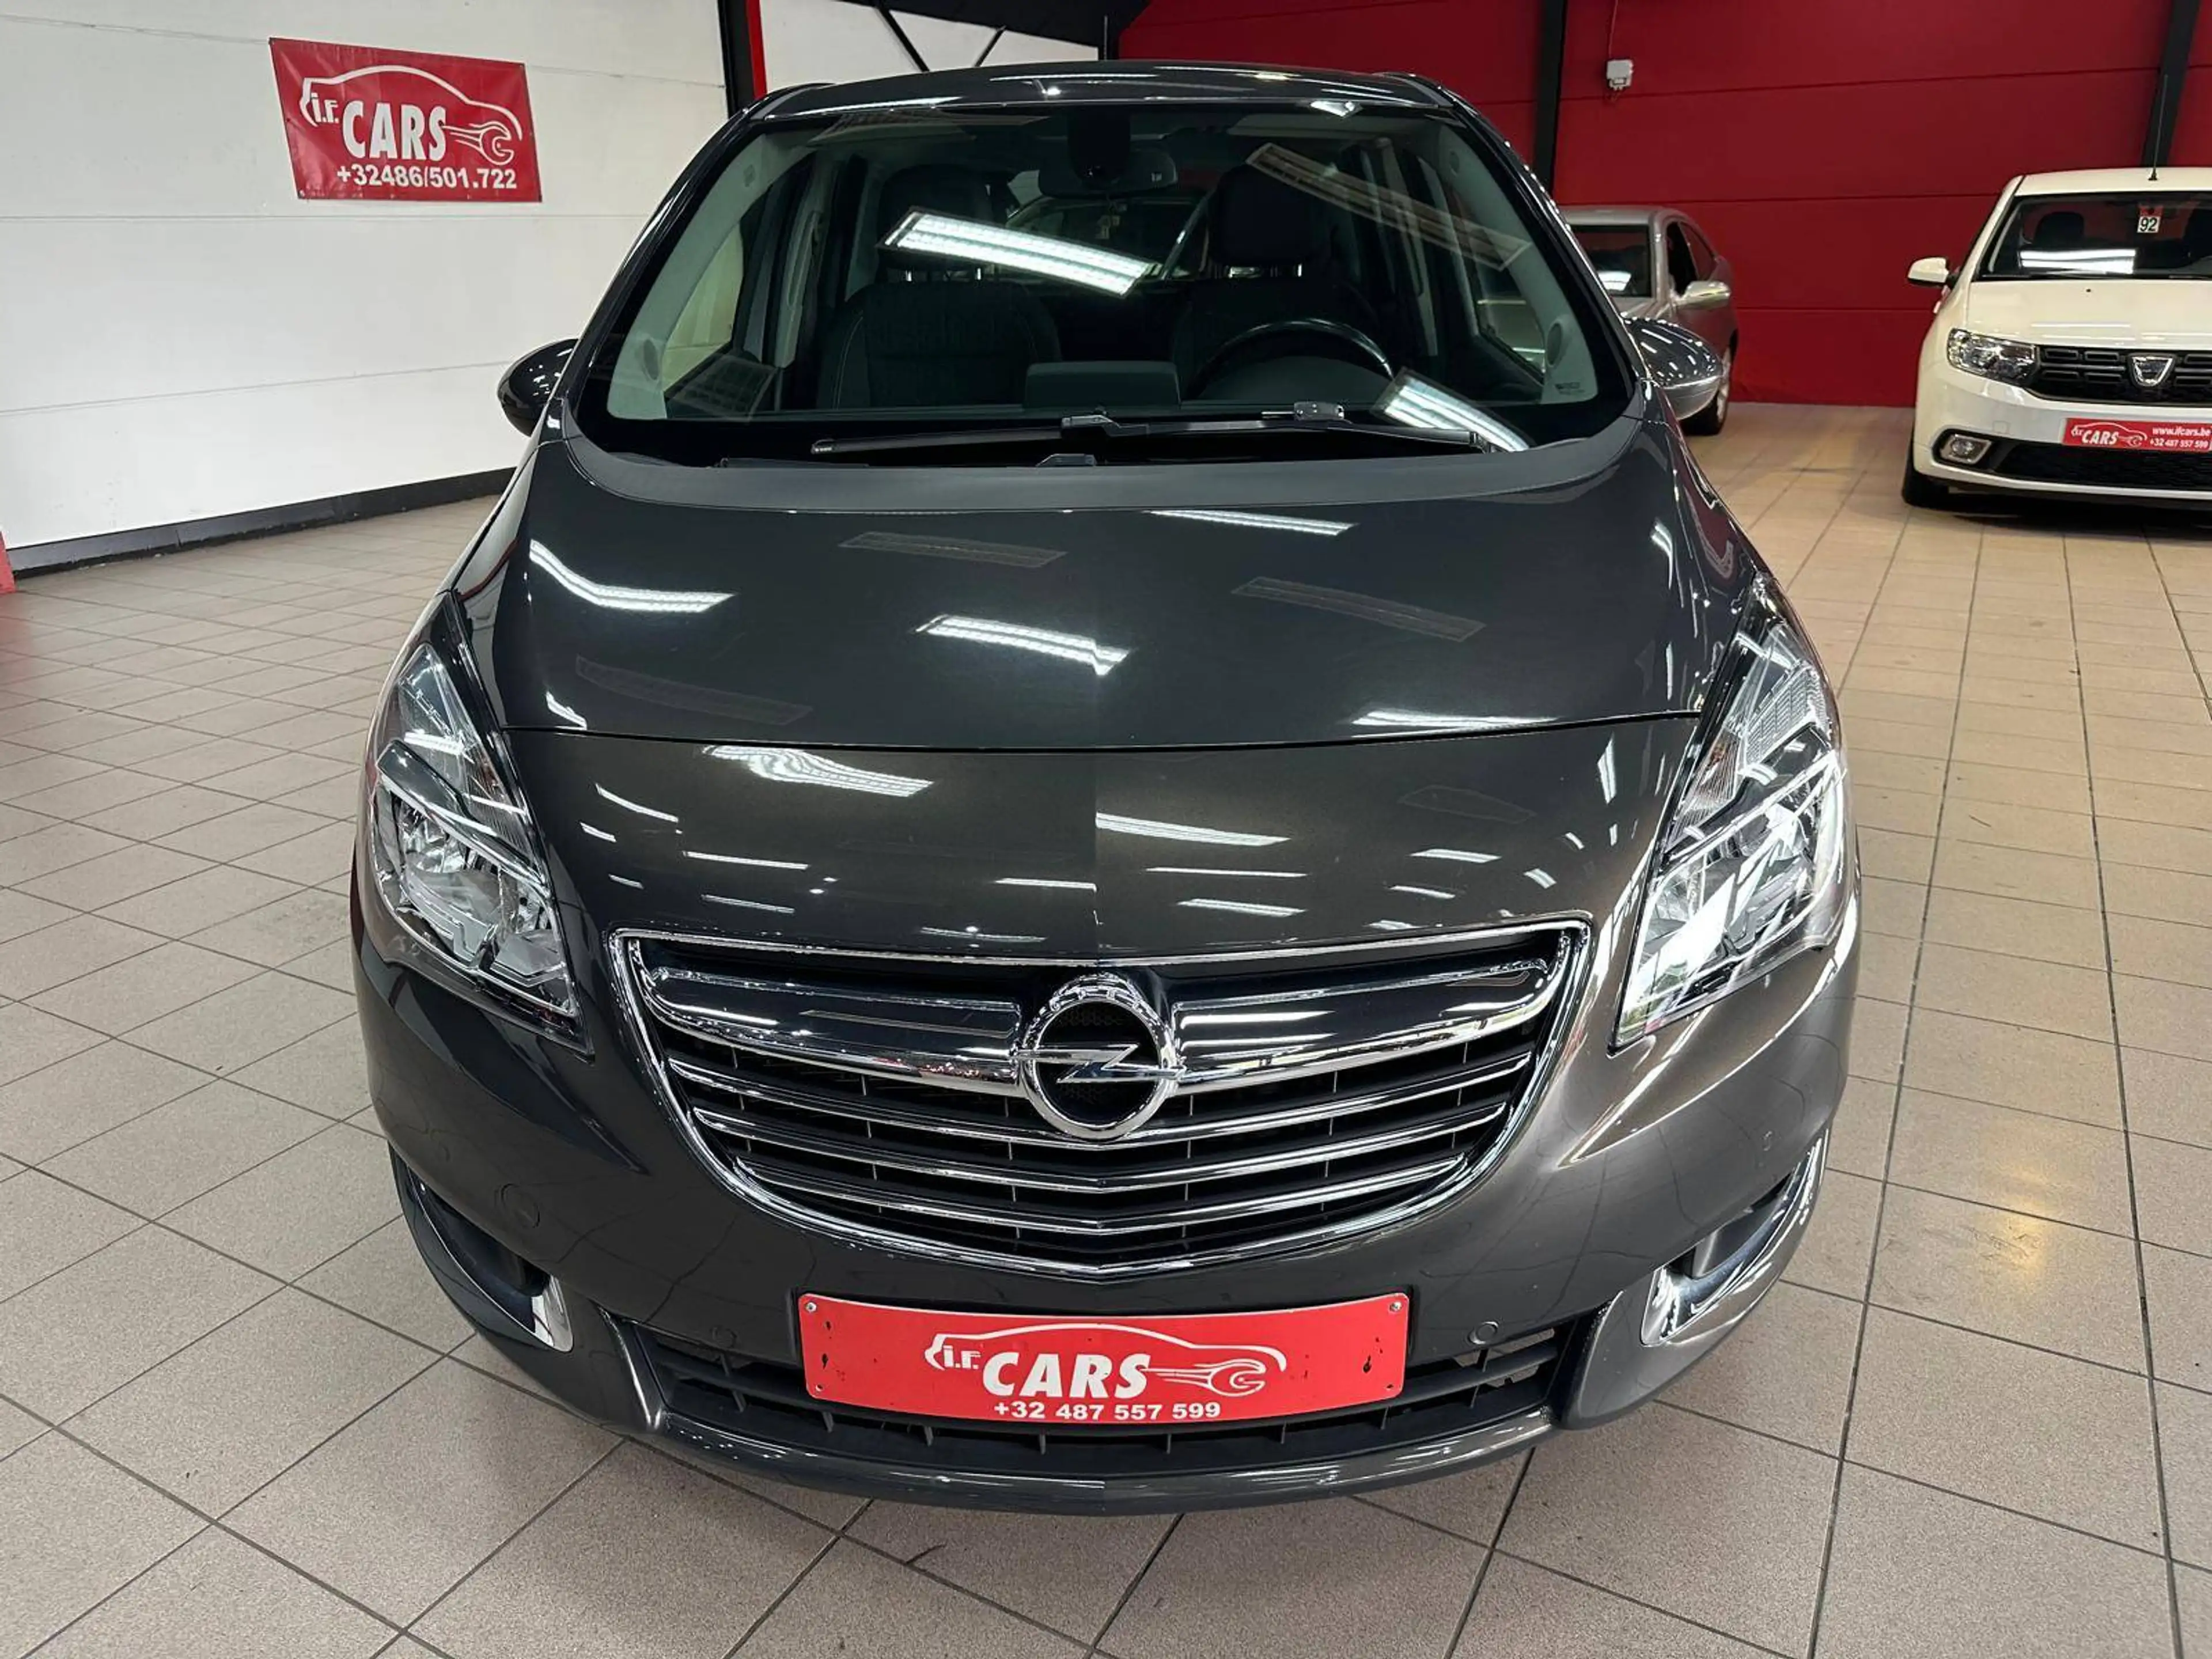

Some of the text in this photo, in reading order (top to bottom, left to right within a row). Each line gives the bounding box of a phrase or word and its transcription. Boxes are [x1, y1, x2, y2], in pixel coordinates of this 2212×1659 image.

[342, 100, 446, 161] CARS
[337, 163, 517, 189] +32486/501.722
[2140, 217, 2158, 232] 92
[2082, 430, 2119, 445] CARS
[983, 1351, 1151, 1399] CARS
[994, 1400, 1221, 1421] +32 487 557 599
